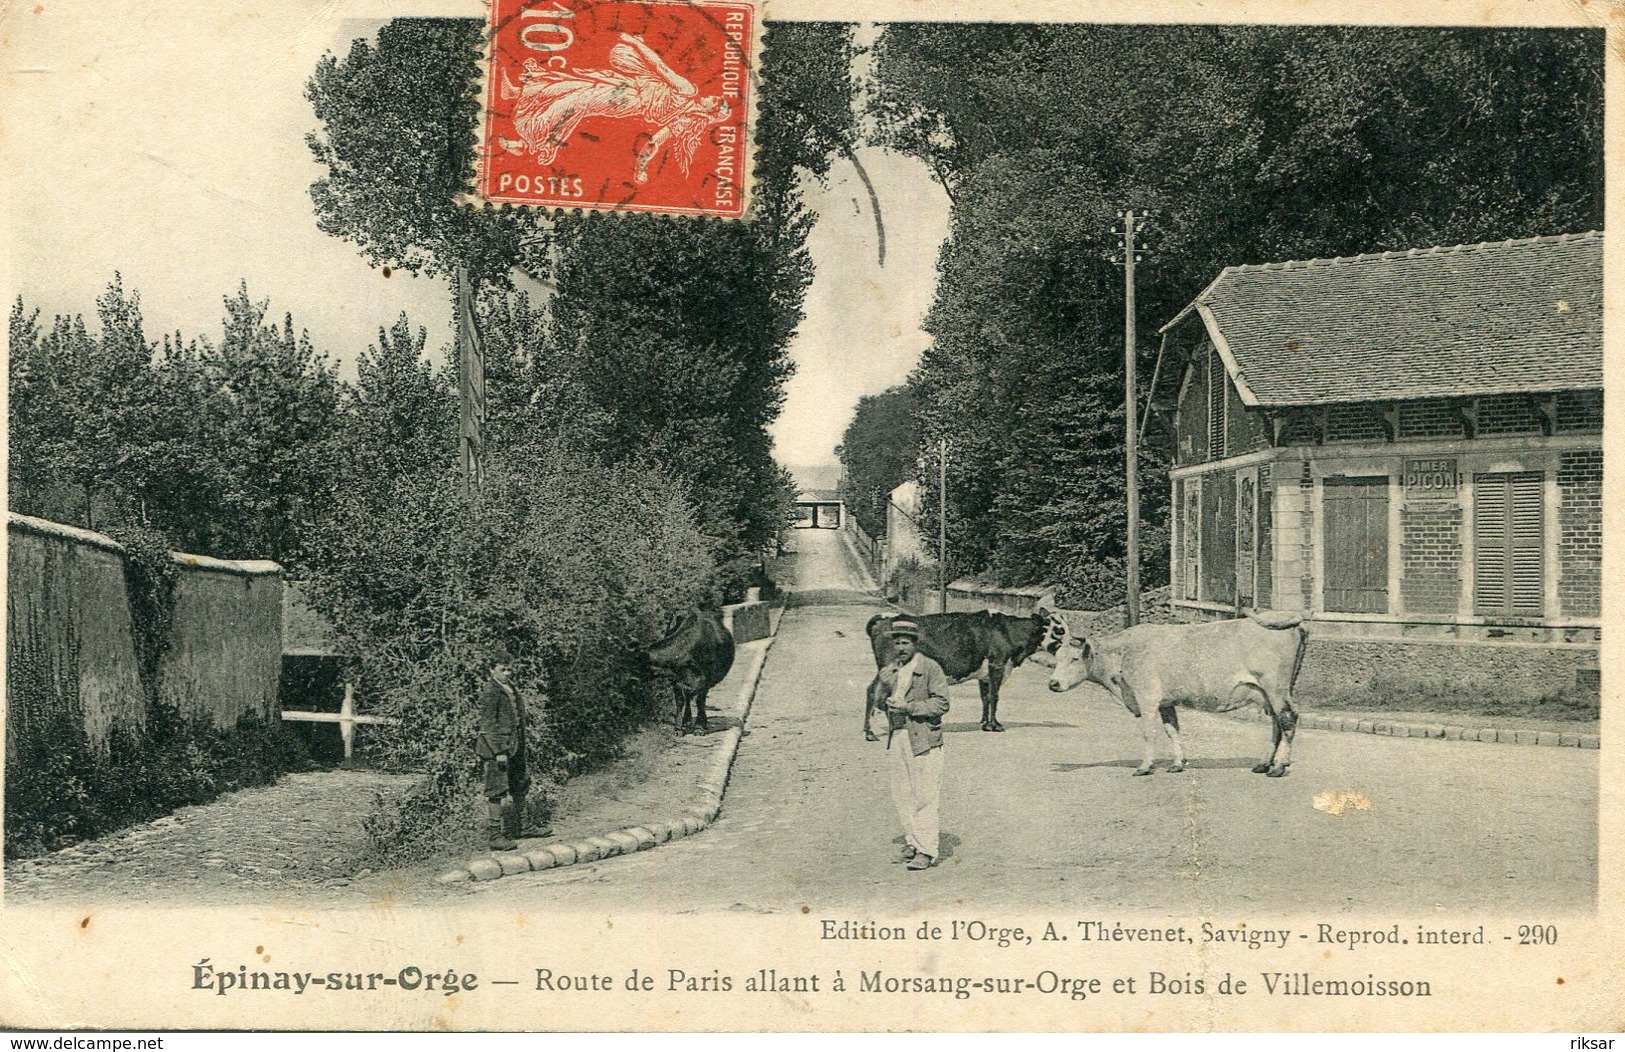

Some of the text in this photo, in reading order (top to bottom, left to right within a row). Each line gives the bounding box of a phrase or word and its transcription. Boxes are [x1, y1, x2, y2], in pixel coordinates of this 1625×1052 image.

[715, 11, 745, 207] REPUBLIQUE FRANÇAISE
[500, 175, 584, 198] POSTES
[1413, 461, 1448, 472] AMER
[1407, 473, 1455, 489] PICON
[820, 919, 906, 941] Edition
[916, 920, 942, 940] de
[1041, 921, 1068, 941] A.
[1077, 920, 1193, 945] Thévenet,
[1201, 921, 1291, 950] Savigny
[1317, 923, 1408, 951] Reprod.
[1518, 924, 1558, 945] 290
[191, 957, 479, 997] Épinay-sur-Orge
[535, 968, 613, 991] Route
[625, 968, 654, 992] de
[667, 969, 733, 992] Paris
[745, 969, 820, 993] allant
[832, 969, 847, 992] à
[860, 970, 1101, 1001] Morsang-sur-Orge
[1112, 977, 1136, 995] et
[1149, 971, 1205, 995] Bois
[1217, 972, 1247, 995] de
[1260, 972, 1432, 997] Villemoisson
